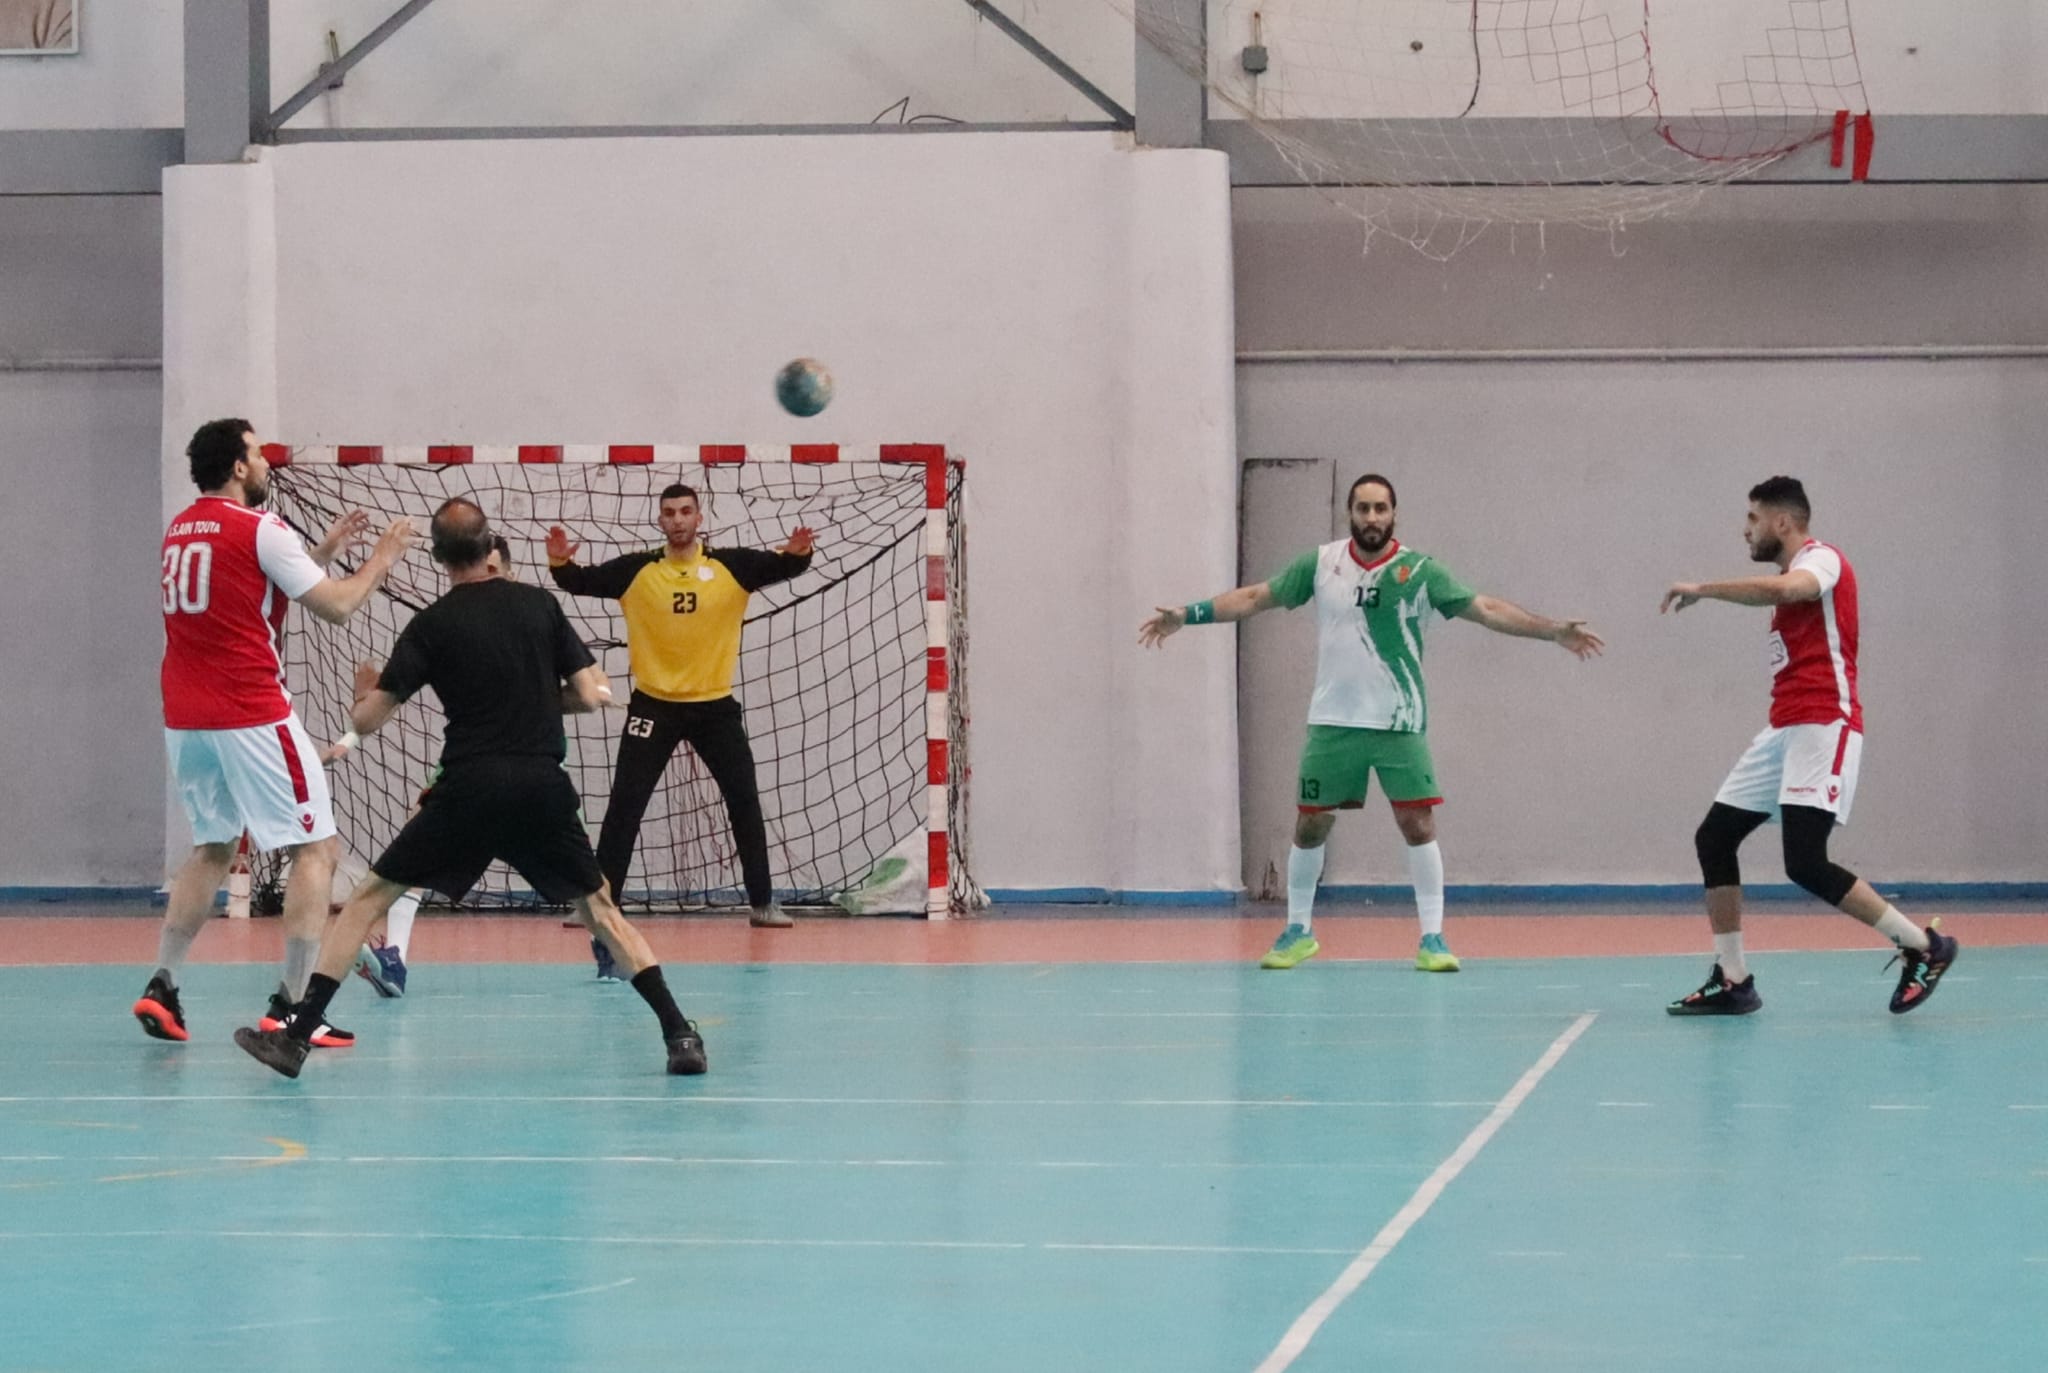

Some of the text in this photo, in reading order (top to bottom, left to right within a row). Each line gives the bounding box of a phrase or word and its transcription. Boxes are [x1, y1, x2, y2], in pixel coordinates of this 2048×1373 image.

[162, 541, 212, 615] 30
[672, 592, 697, 614] 23
[1353, 585, 1381, 608] 13
[628, 716, 655, 738] 23
[1301, 777, 1321, 800] 13
